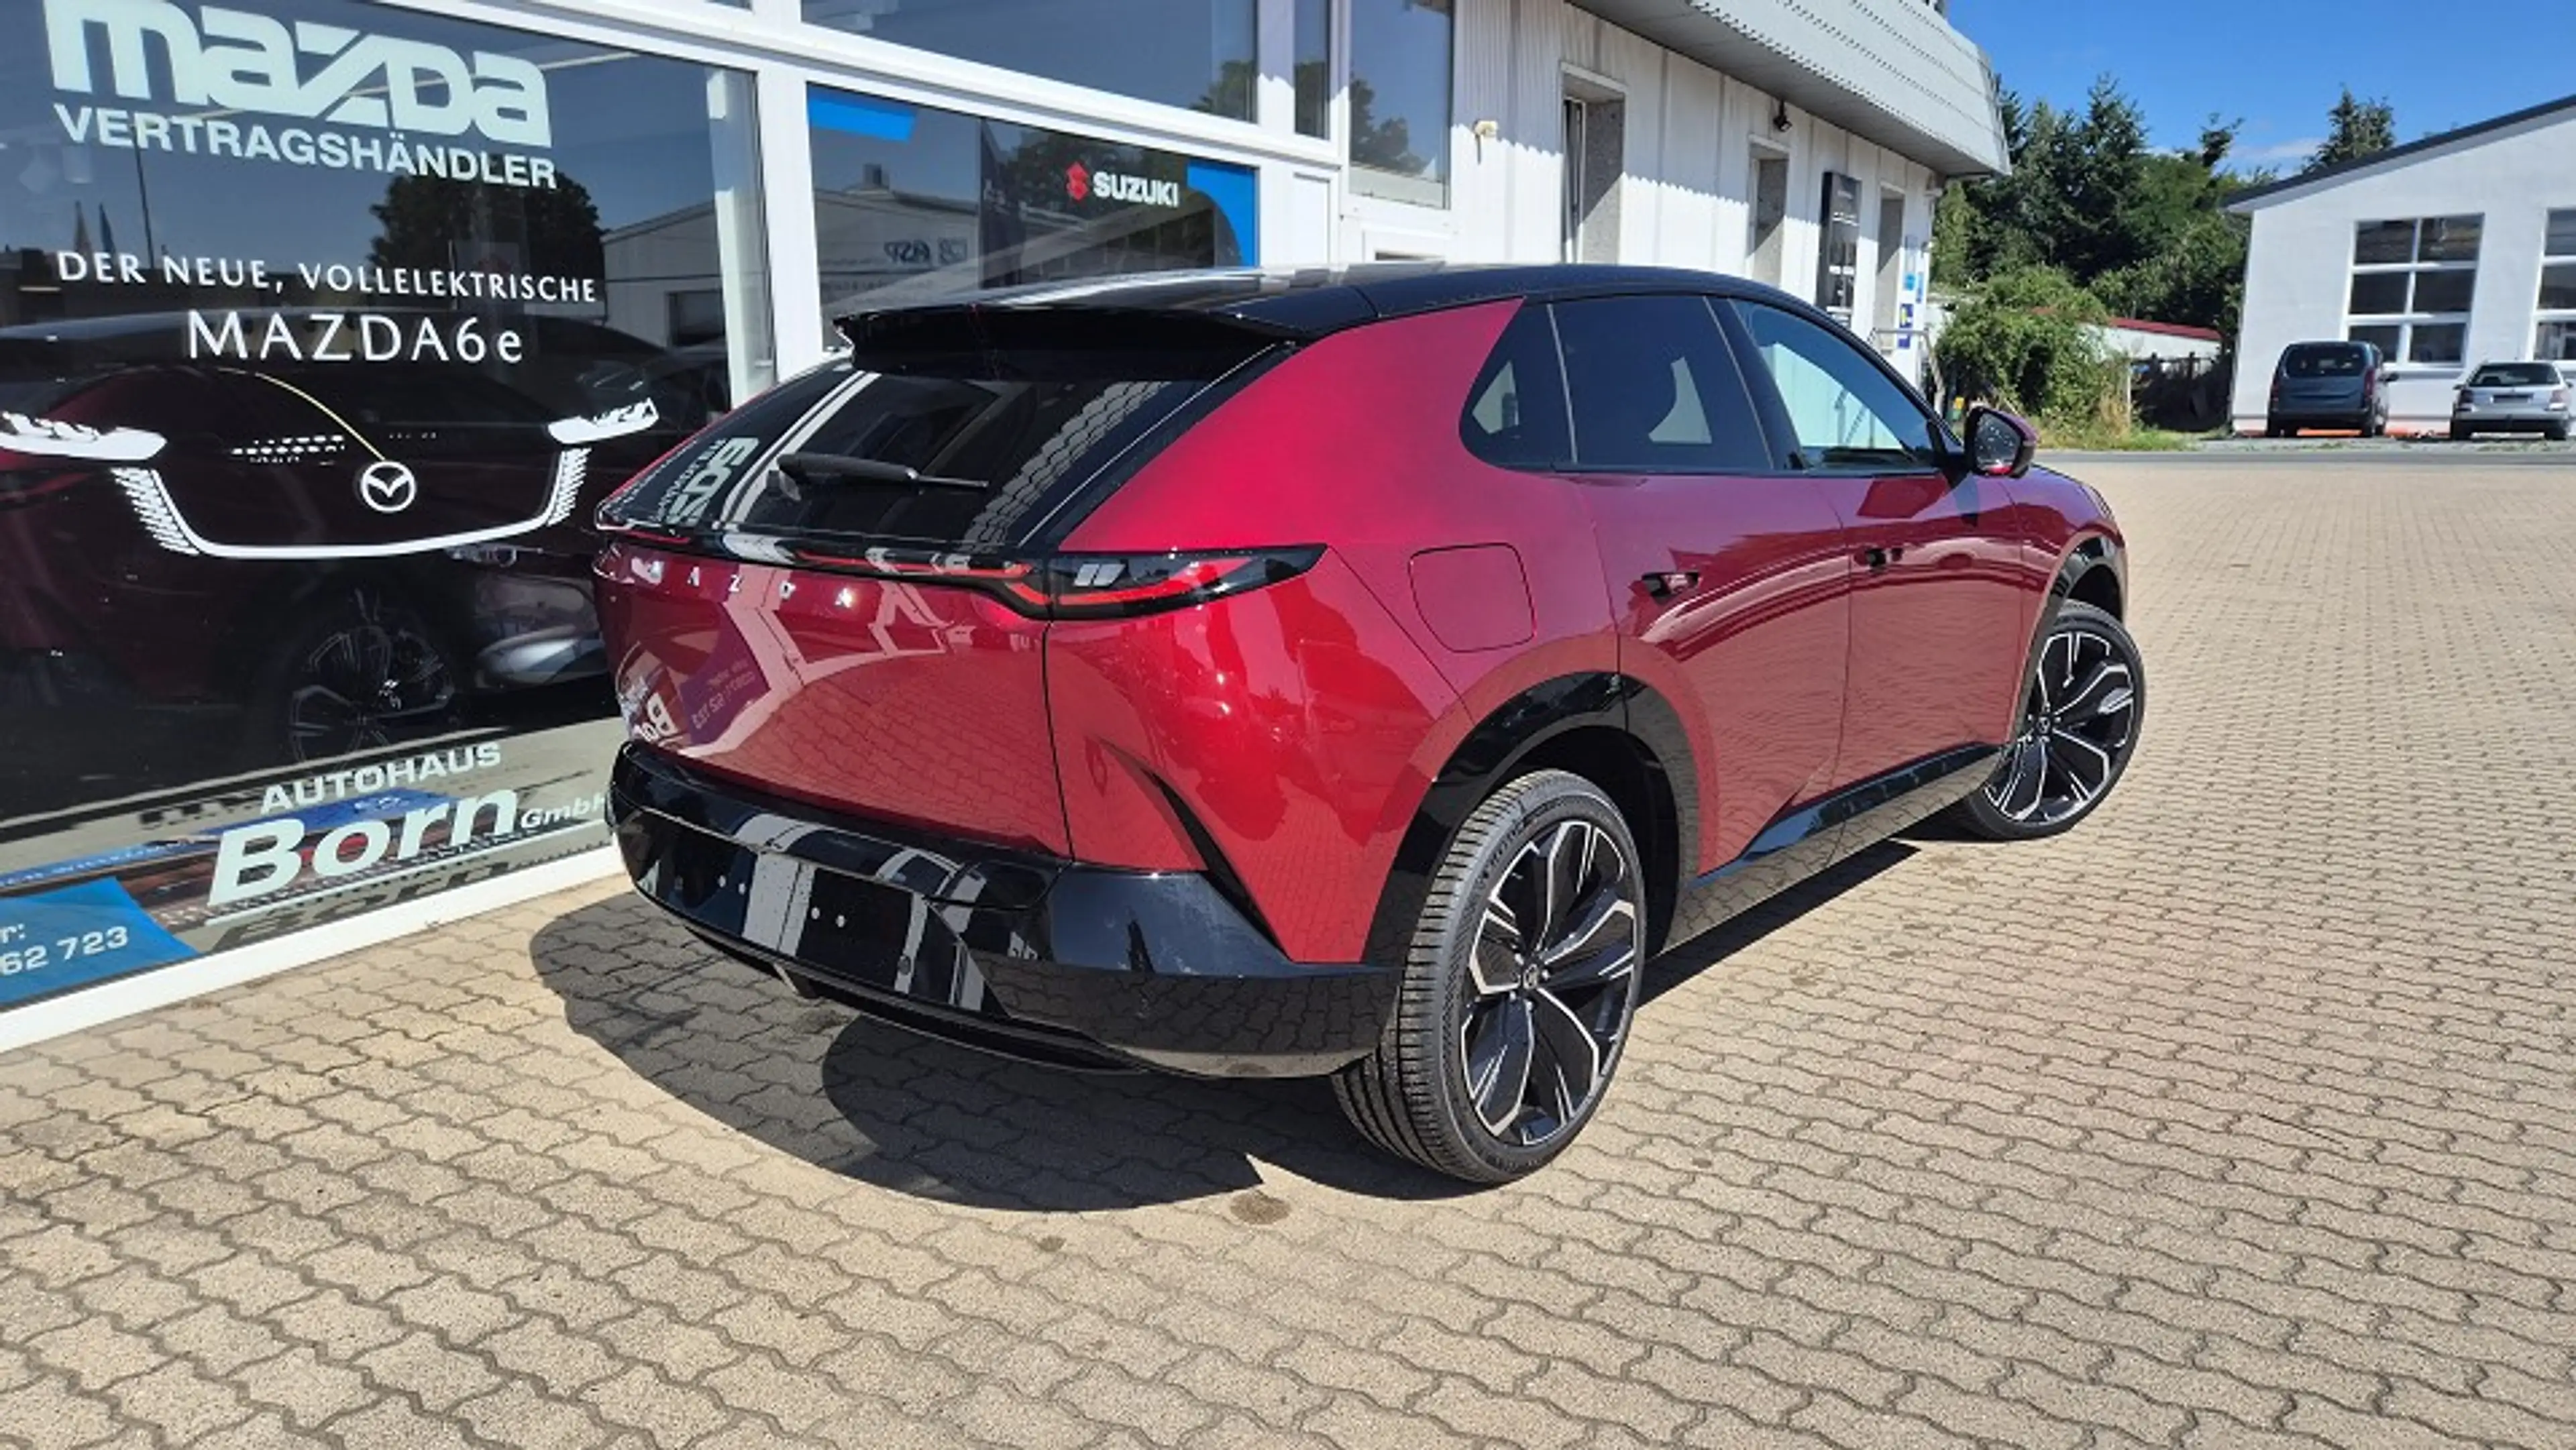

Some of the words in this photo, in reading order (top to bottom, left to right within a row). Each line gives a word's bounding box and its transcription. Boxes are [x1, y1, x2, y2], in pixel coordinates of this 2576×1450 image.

[54, 102, 557, 189] VERTRAGSHÄNDLER
[1093, 171, 1179, 207] SUZUKI
[56, 250, 143, 284] DER
[162, 254, 284, 294] NEUE,
[298, 263, 596, 302] VOLLELEKTRISCHE
[187, 309, 523, 363] MAZDA6e
[260, 742, 502, 815] AUTOHAUS
[207, 789, 518, 907] Born
[56, 926, 129, 961] 723
